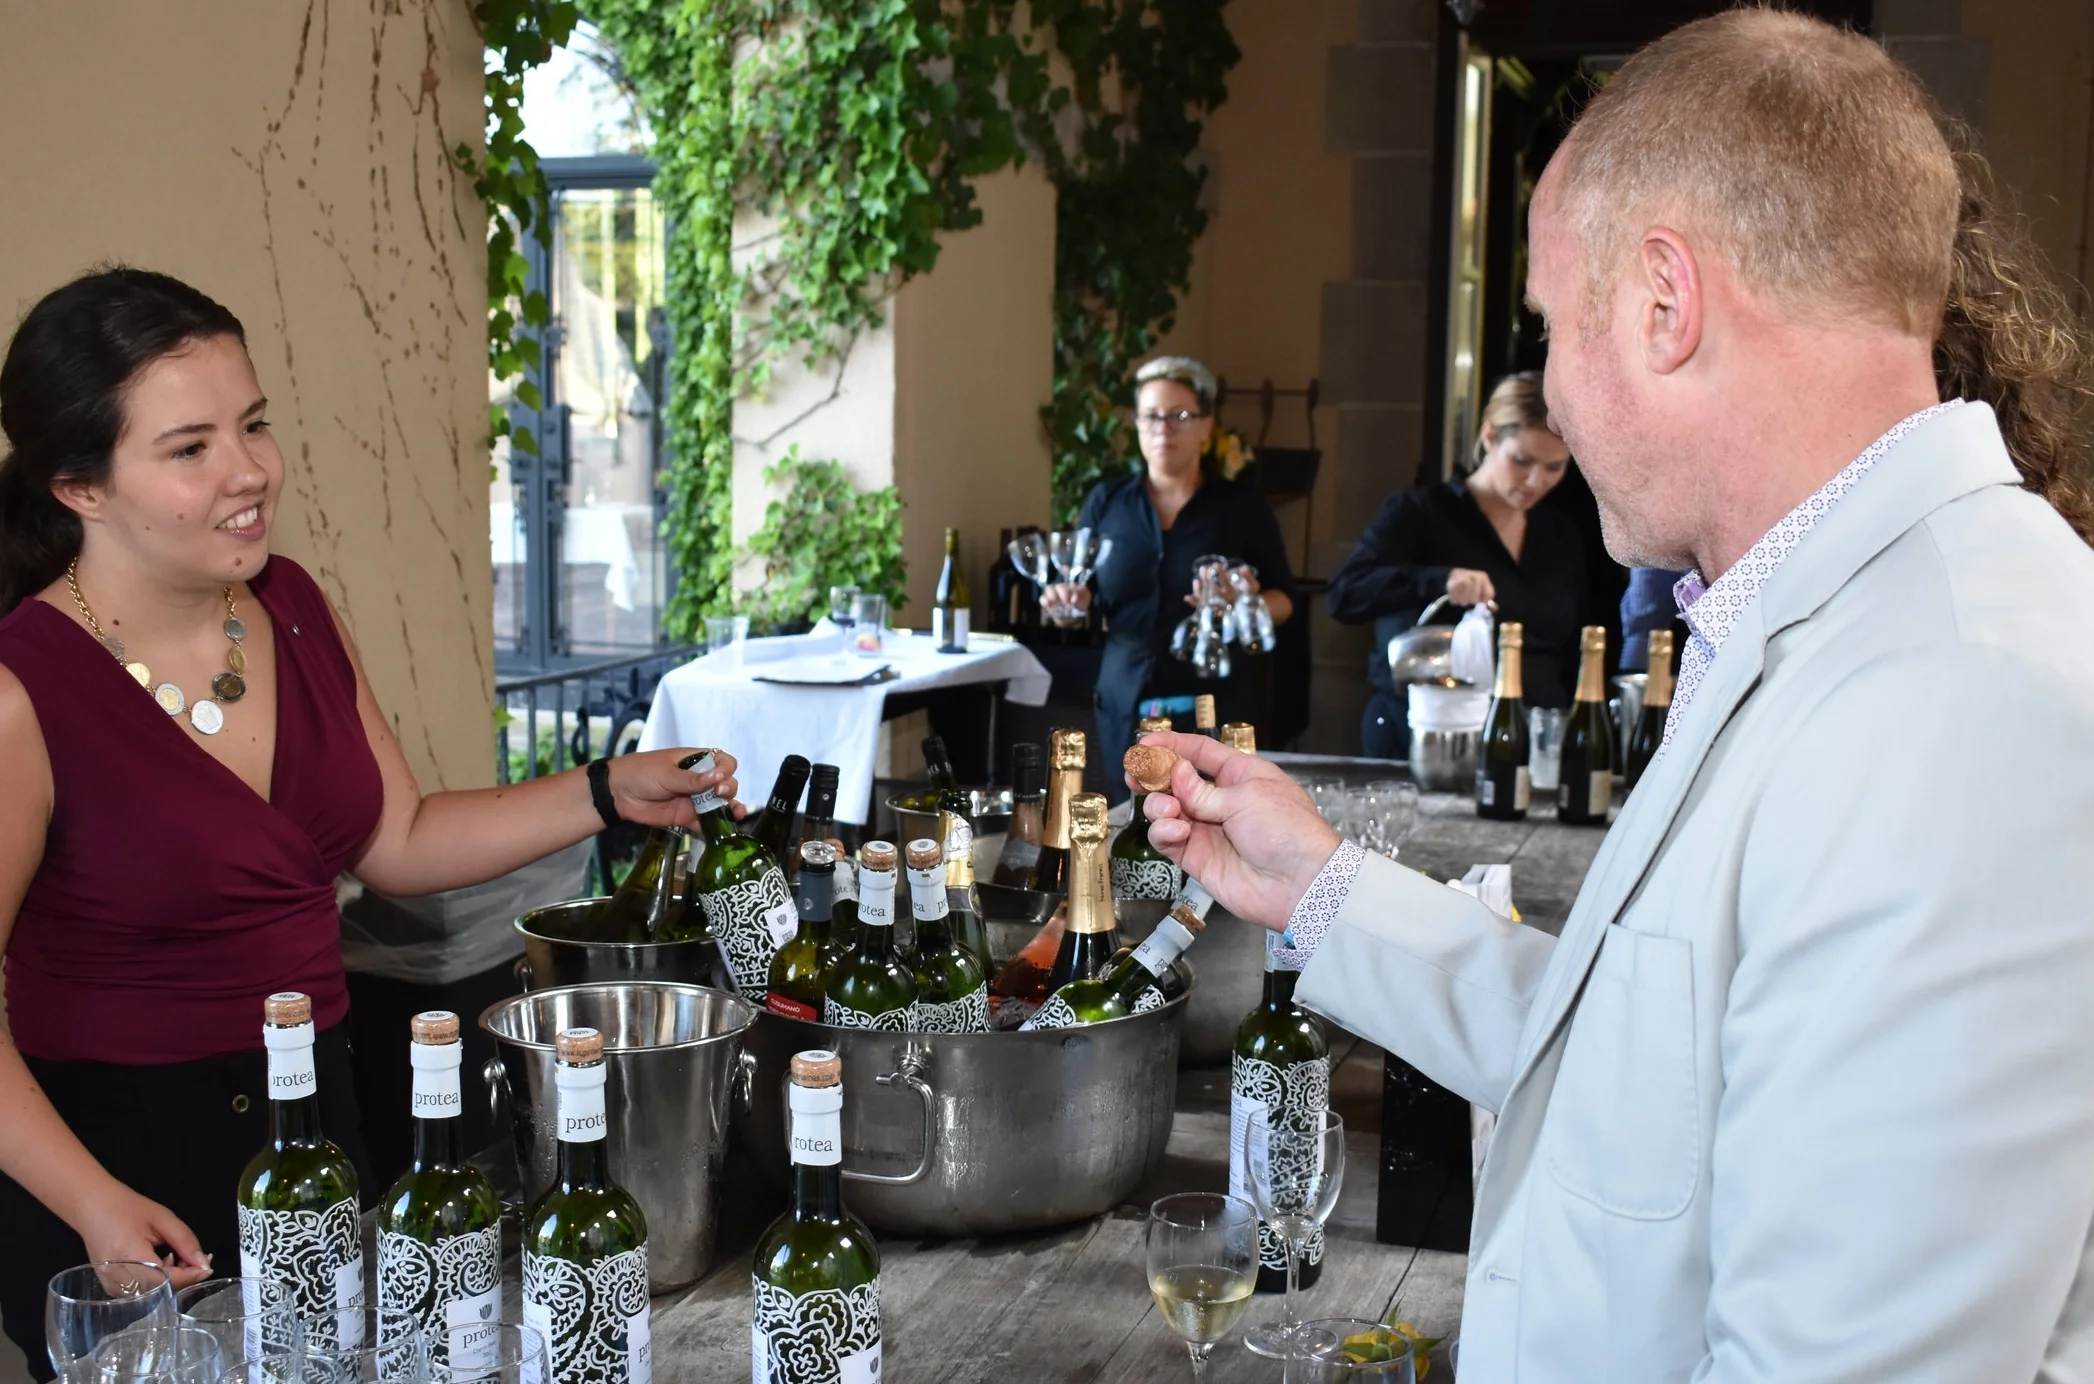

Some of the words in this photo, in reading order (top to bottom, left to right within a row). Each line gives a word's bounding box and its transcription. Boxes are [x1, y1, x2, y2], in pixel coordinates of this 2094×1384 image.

[860, 902, 886, 918] rotea
[415, 1091, 459, 1108] protea
[565, 1112, 606, 1134] prote
[795, 1136, 833, 1153] rotea
